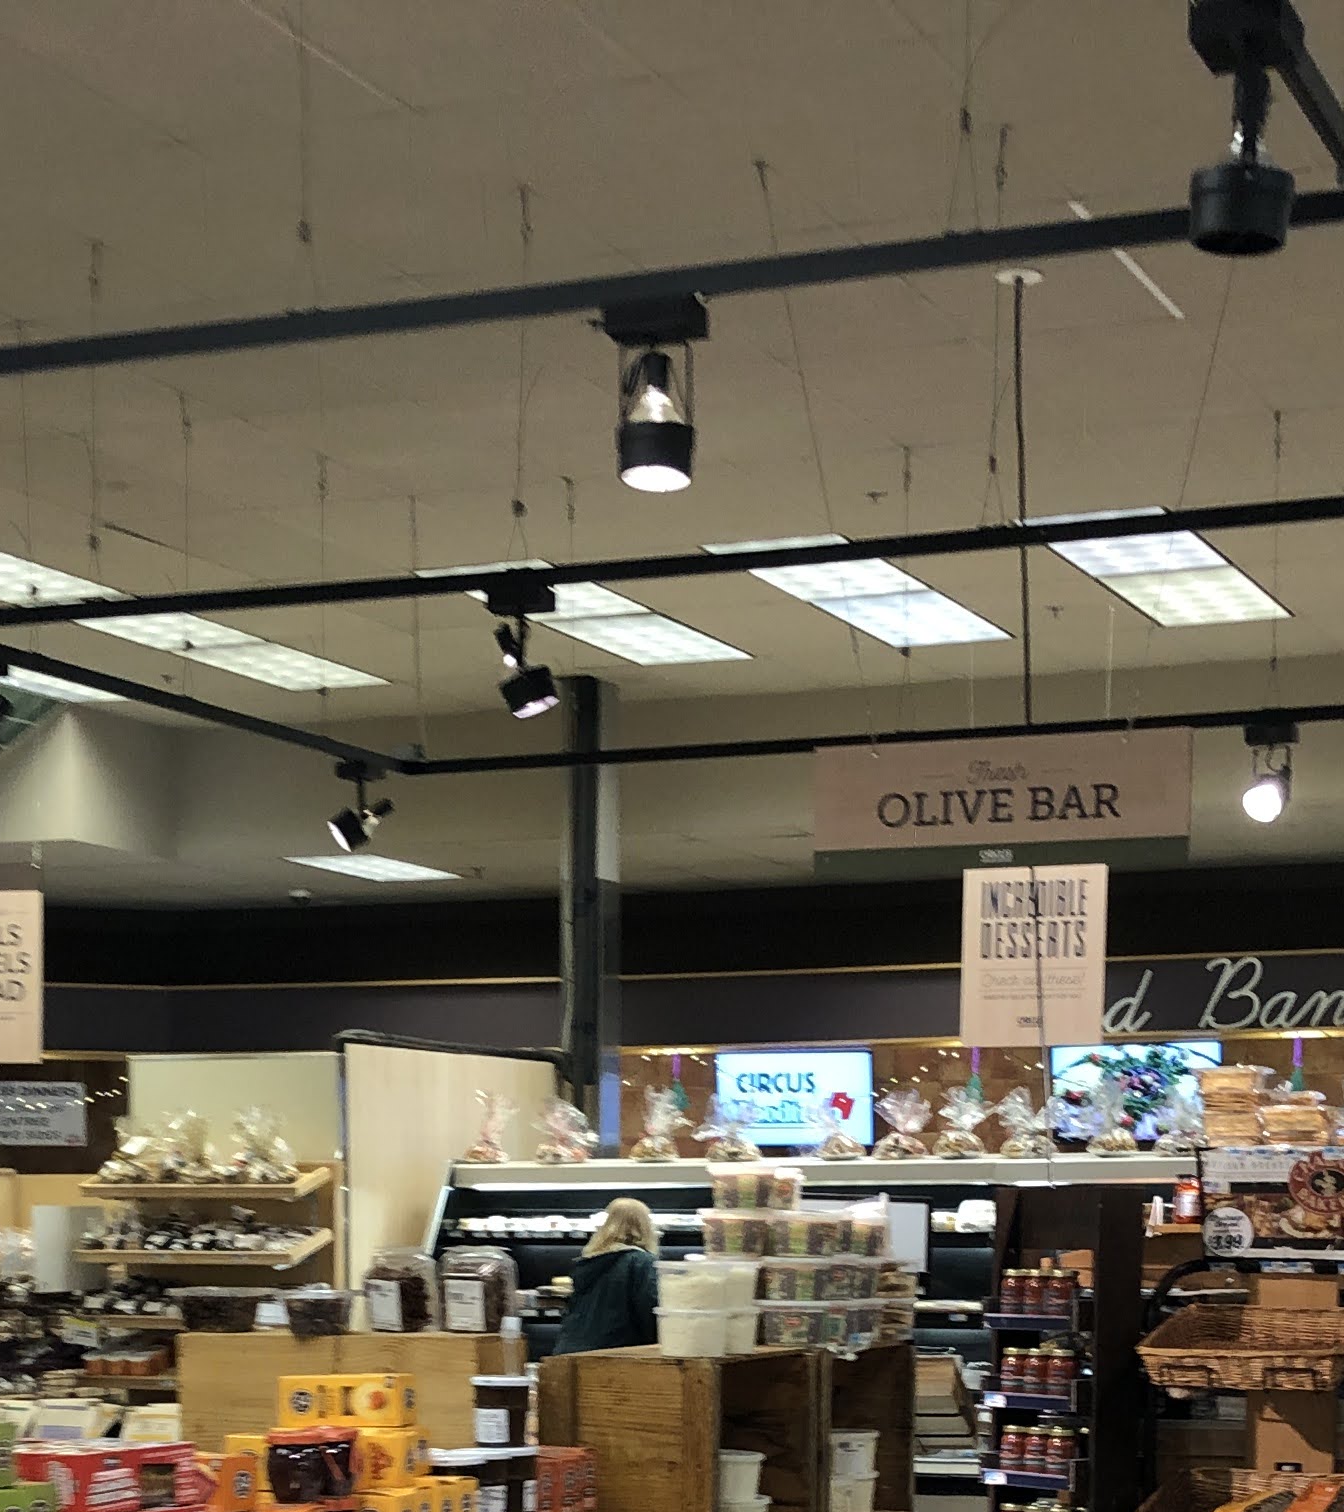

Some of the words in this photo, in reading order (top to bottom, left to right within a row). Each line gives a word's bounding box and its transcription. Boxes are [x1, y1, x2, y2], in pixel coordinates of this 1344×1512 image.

[876, 786, 1015, 828] OLIVE
[1025, 782, 1122, 821] BAR
[980, 879, 1089, 919] INCREDIBLE
[979, 920, 1088, 960] DESSERTS
[736, 1072, 816, 1094] CIRCUS
